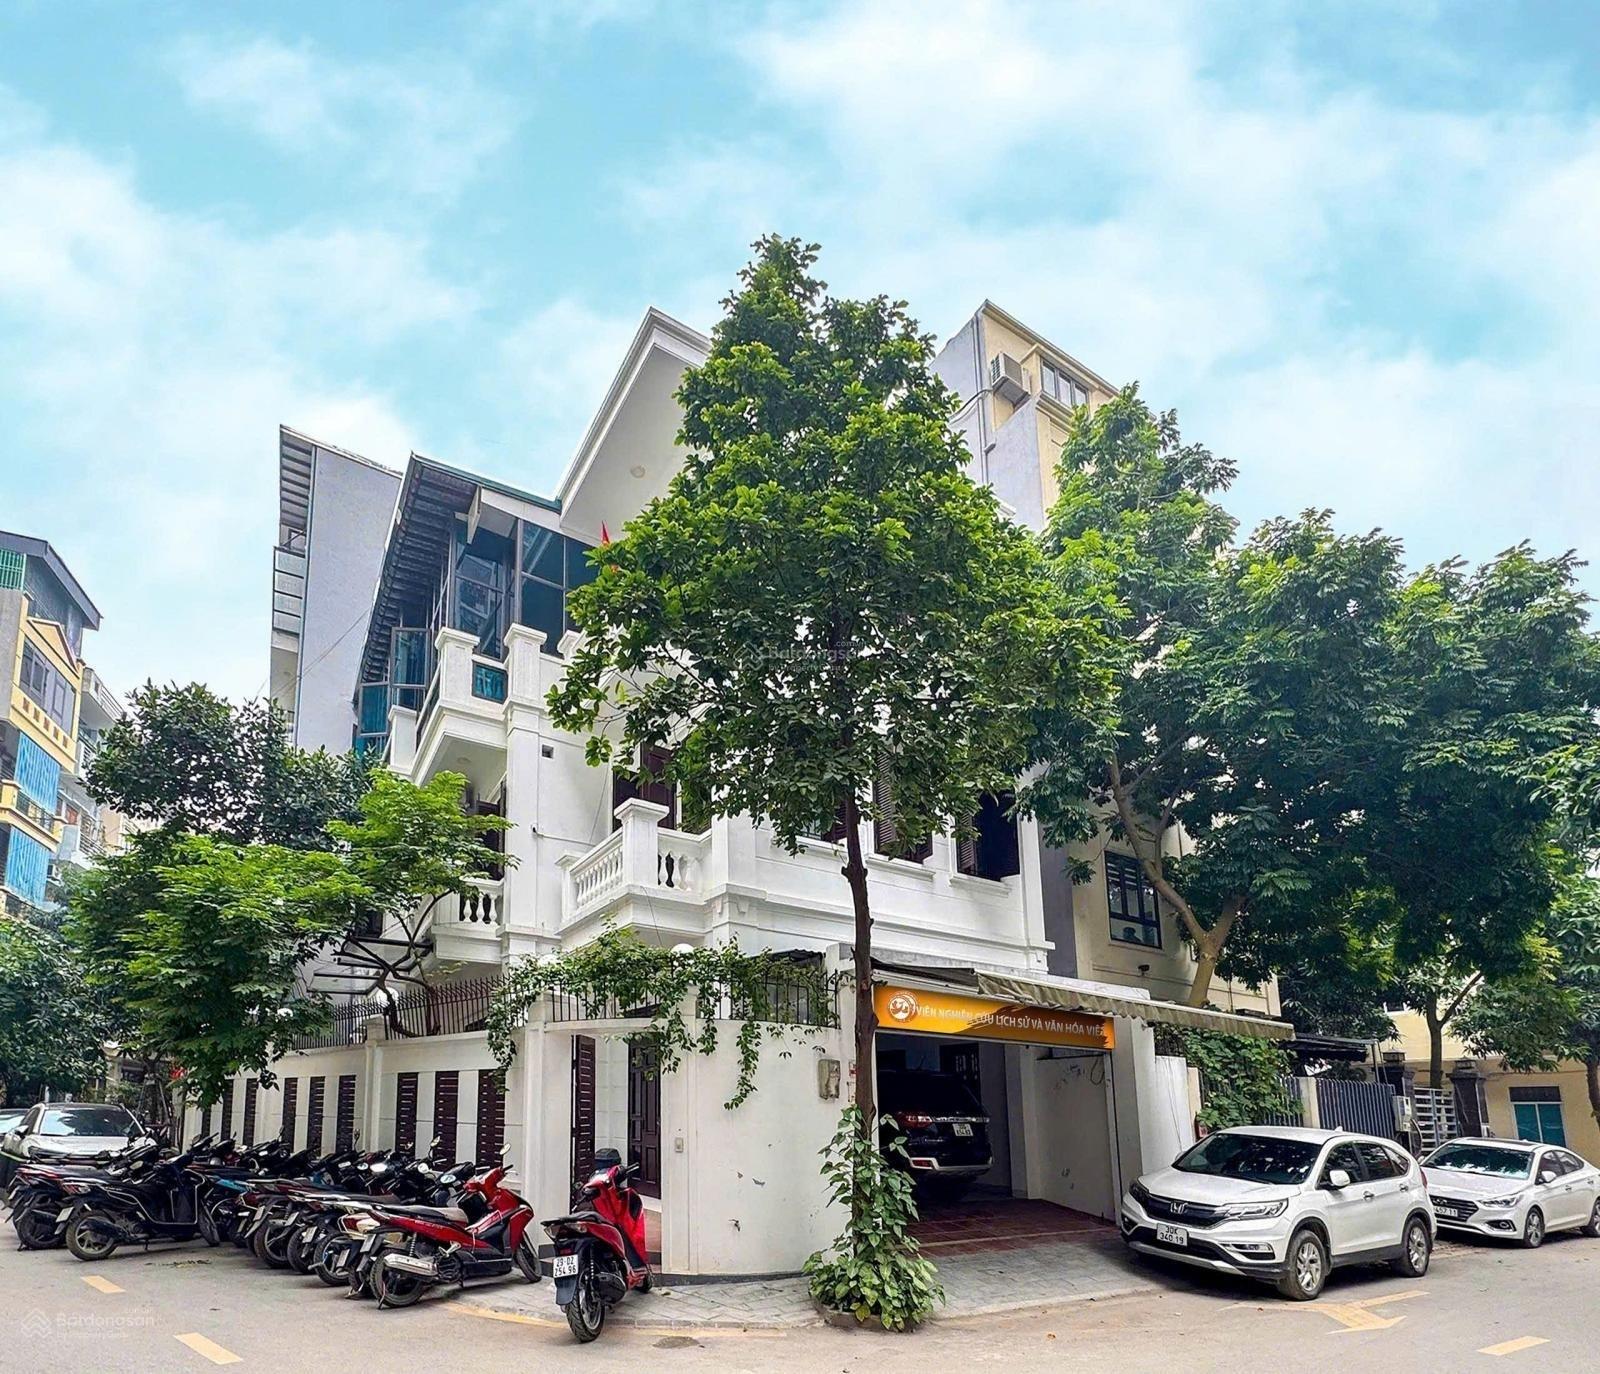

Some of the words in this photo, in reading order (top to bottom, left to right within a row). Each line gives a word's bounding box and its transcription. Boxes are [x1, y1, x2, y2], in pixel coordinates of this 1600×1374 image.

[996, 1014, 1016, 1029] LỊCH
[1017, 1016, 1031, 1029] SỬ
[1031, 1018, 1043, 1030] VÀ
[1045, 1019, 1063, 1033] VĂN
[1065, 1022, 1085, 1035] HÓA
[1165, 1225, 1178, 1235] 30K
